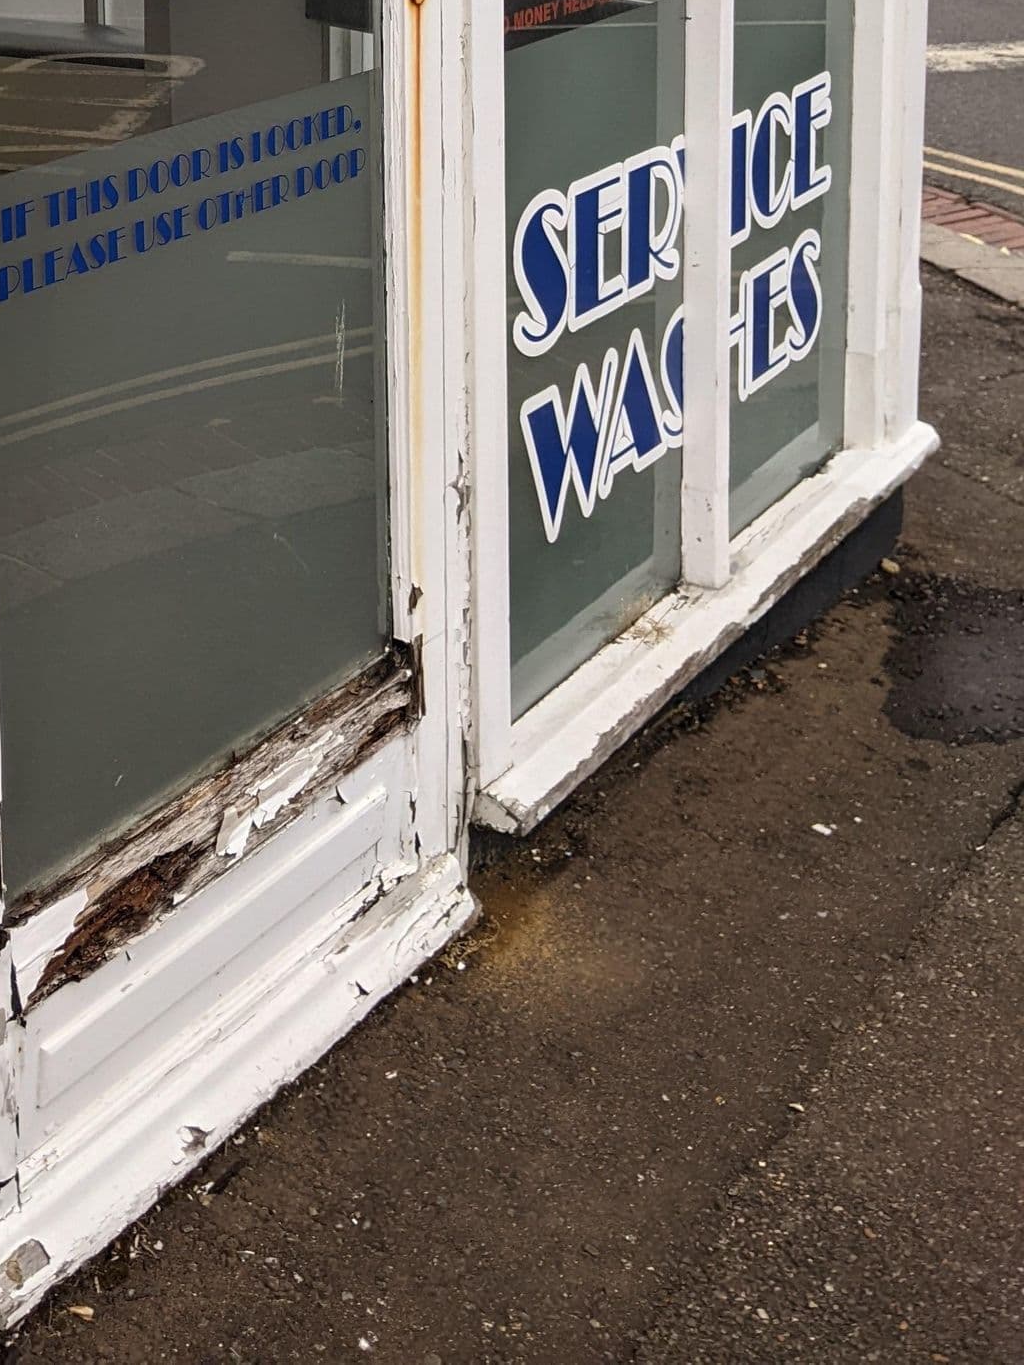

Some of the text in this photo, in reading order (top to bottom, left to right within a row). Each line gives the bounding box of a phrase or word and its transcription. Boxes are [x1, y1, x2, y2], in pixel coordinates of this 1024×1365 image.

[0, 199, 35, 244] IF
[42, 174, 119, 229] THIS
[127, 148, 213, 203] DOOR
[218, 136, 246, 174] IS
[134, 204, 192, 254] USE
[197, 174, 291, 232] OTHER
